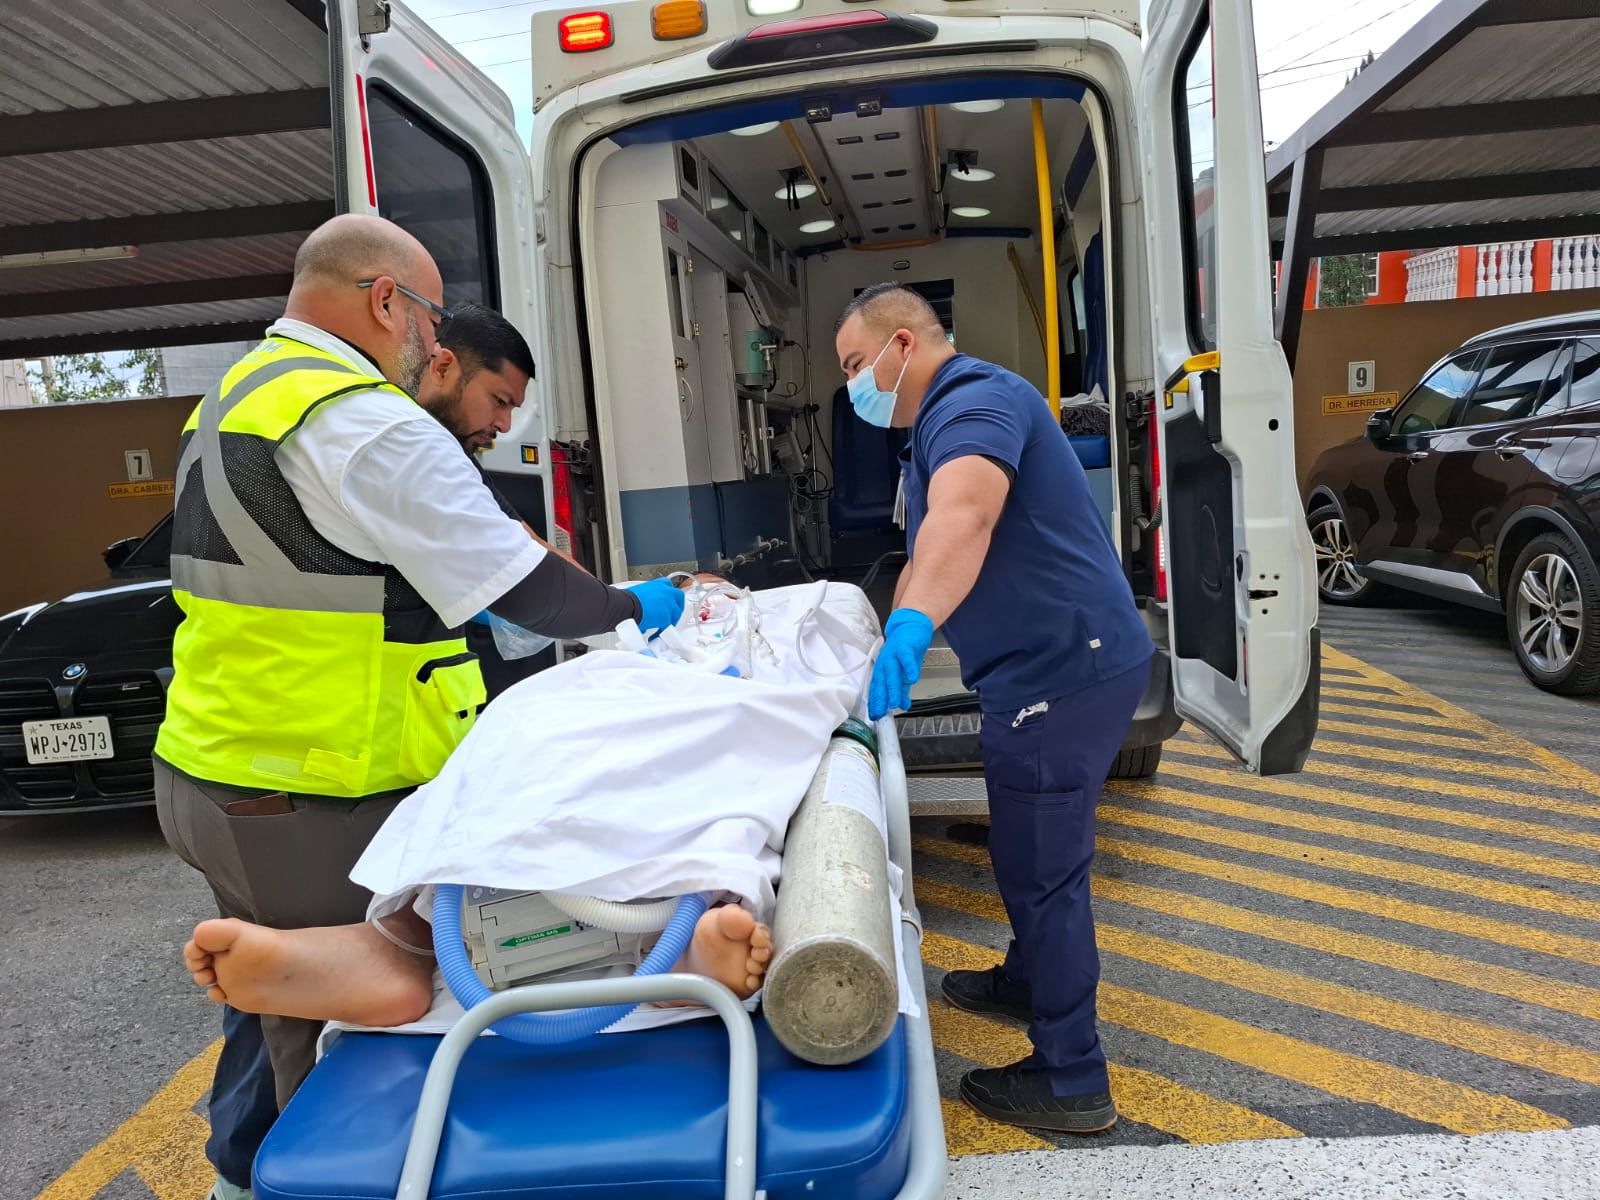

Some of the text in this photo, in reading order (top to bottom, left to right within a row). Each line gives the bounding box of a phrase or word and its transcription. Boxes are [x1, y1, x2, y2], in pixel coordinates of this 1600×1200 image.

[1356, 367, 1367, 388] 9
[1329, 397, 1391, 410] DR. HERRERA
[133, 456, 142, 475] 7
[50, 722, 82, 731] TEXAS
[515, 933, 545, 943] OPTIMA
